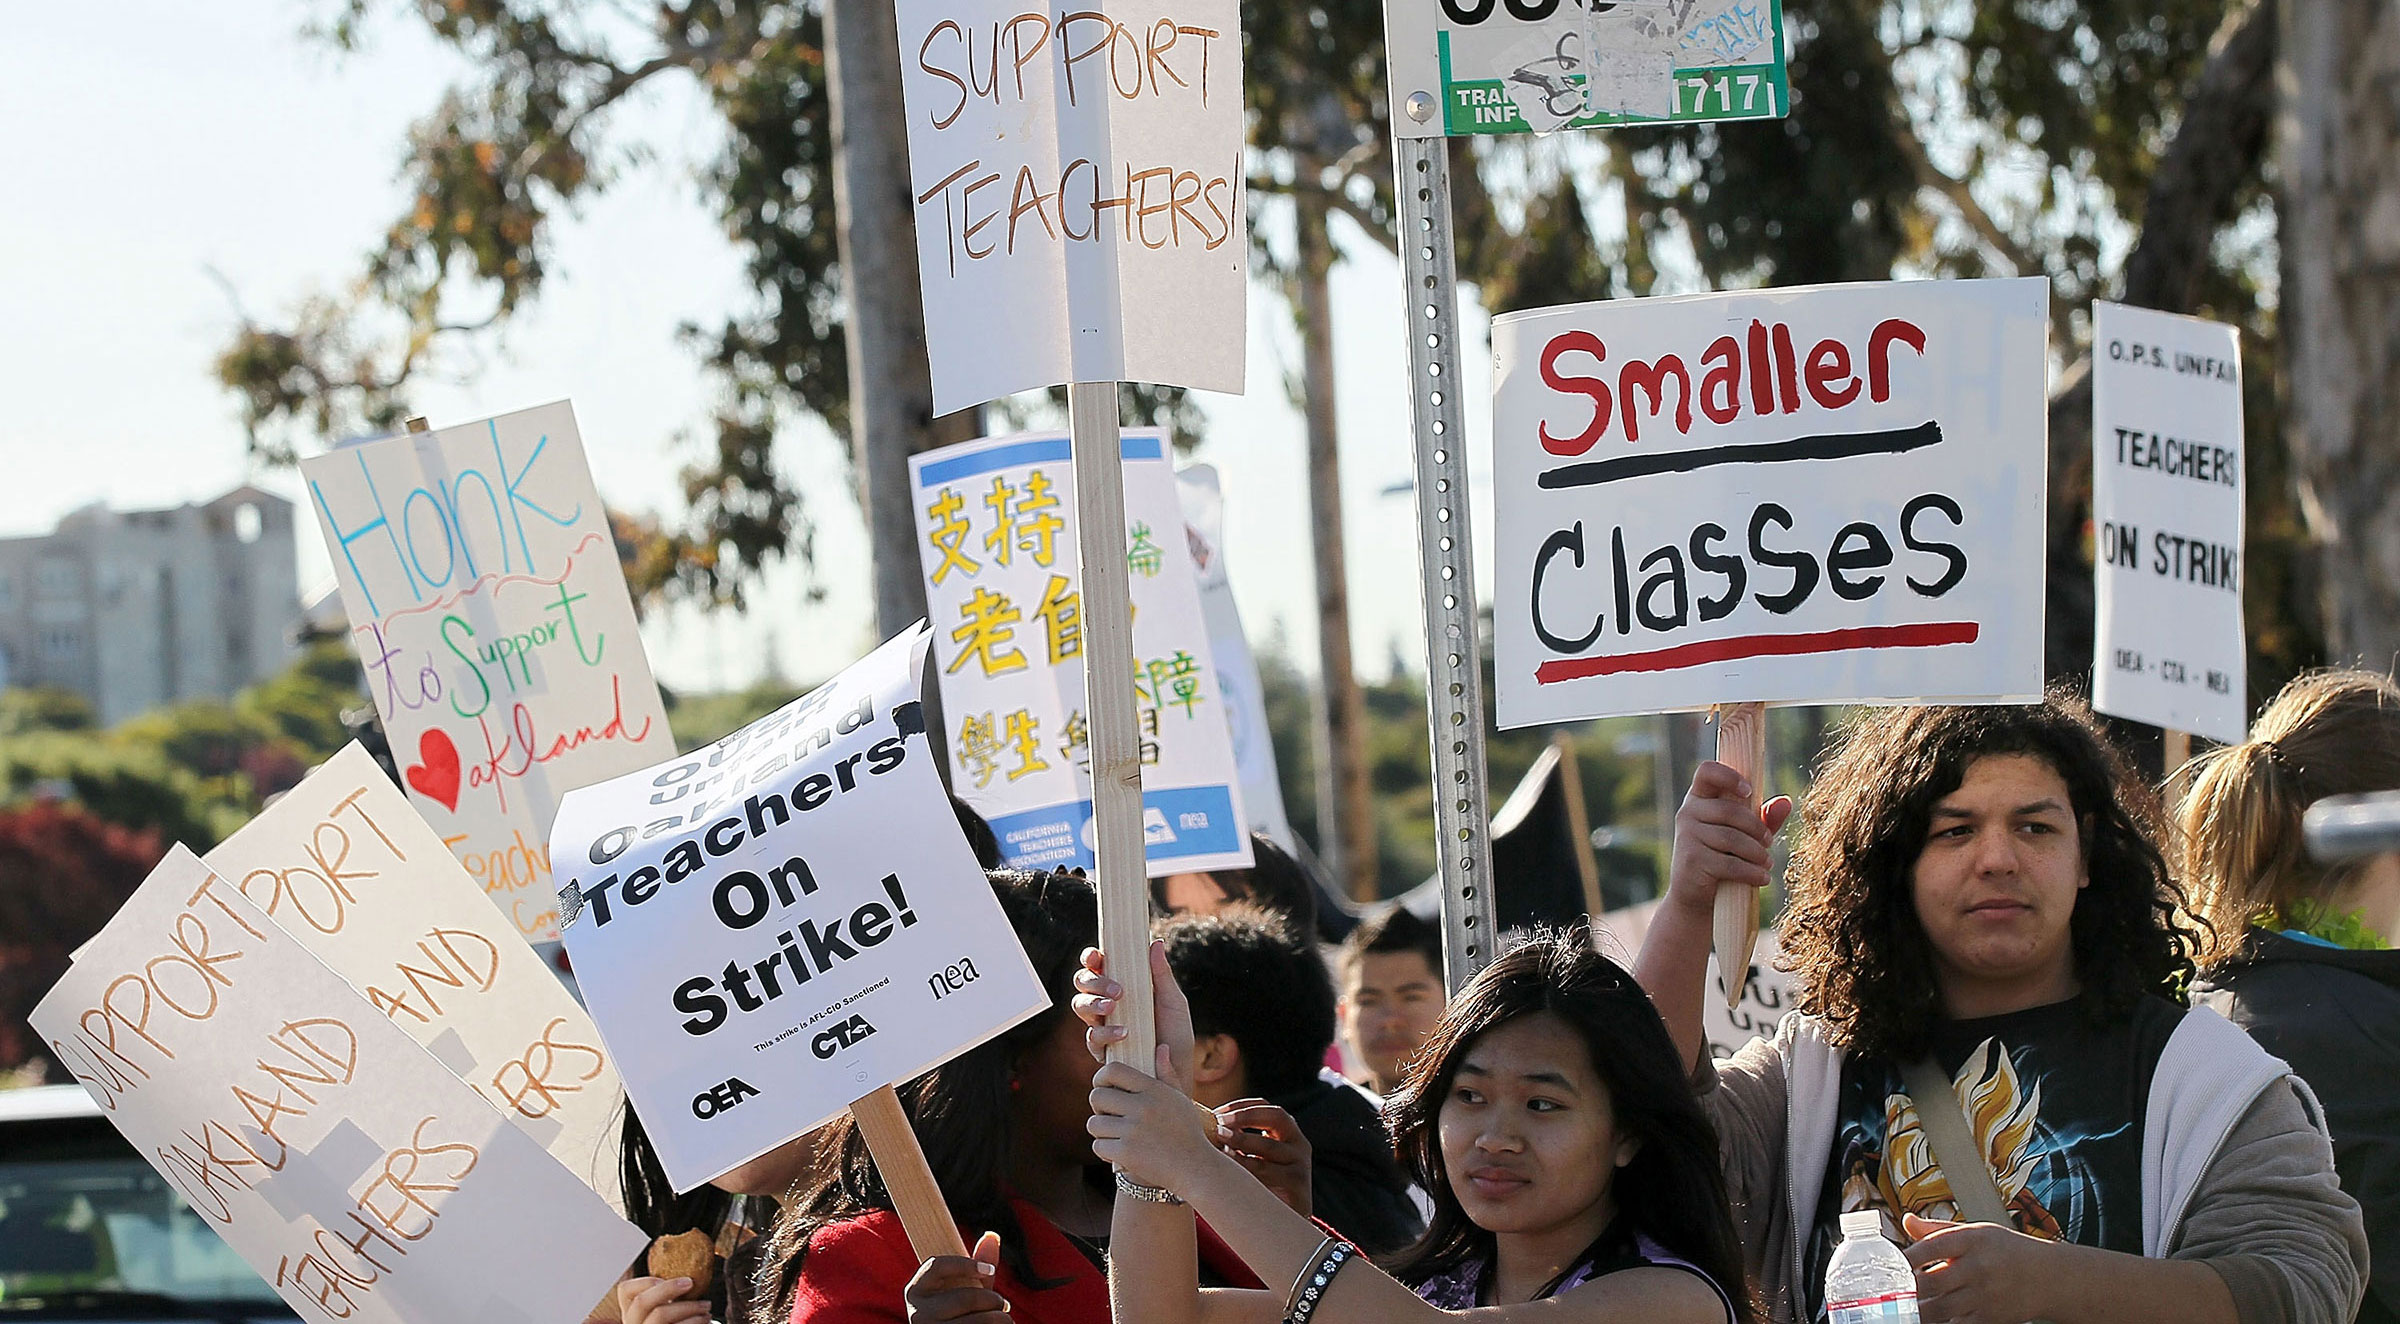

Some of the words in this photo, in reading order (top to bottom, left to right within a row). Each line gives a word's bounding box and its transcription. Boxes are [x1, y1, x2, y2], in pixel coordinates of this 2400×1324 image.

[919, 11, 1220, 129] SUPPORT
[1475, 106, 1517, 124] INF
[918, 152, 1239, 278] TEACHERS!
[1539, 317, 1926, 457] Smaller
[2174, 351, 2237, 385] UNFAI
[312, 418, 582, 618] Honk
[2115, 428, 2236, 488] TEACHERS
[1531, 492, 1969, 655] Classes
[2103, 521, 2138, 569] ON
[2154, 531, 2238, 593] STRIK
[368, 621, 442, 722] to
[439, 581, 605, 719] Support
[582, 734, 909, 929] Teachers
[587, 693, 876, 866] Oakland
[671, 871, 920, 1038] Strike!
[711, 855, 819, 931] On
[53, 872, 268, 1110] SUPPORT
[753, 1040, 774, 1053] This
[774, 1026, 799, 1042] strike
[799, 1021, 808, 1030] is
[809, 1002, 842, 1025] AFL-CIO
[842, 976, 890, 1006] Sanctioned
[811, 1013, 877, 1060] CTA
[927, 956, 980, 1001] nea
[157, 1017, 358, 1224] OAKLAND
[690, 1075, 761, 1121] OEA
[276, 1116, 479, 1321] TEACHERS
